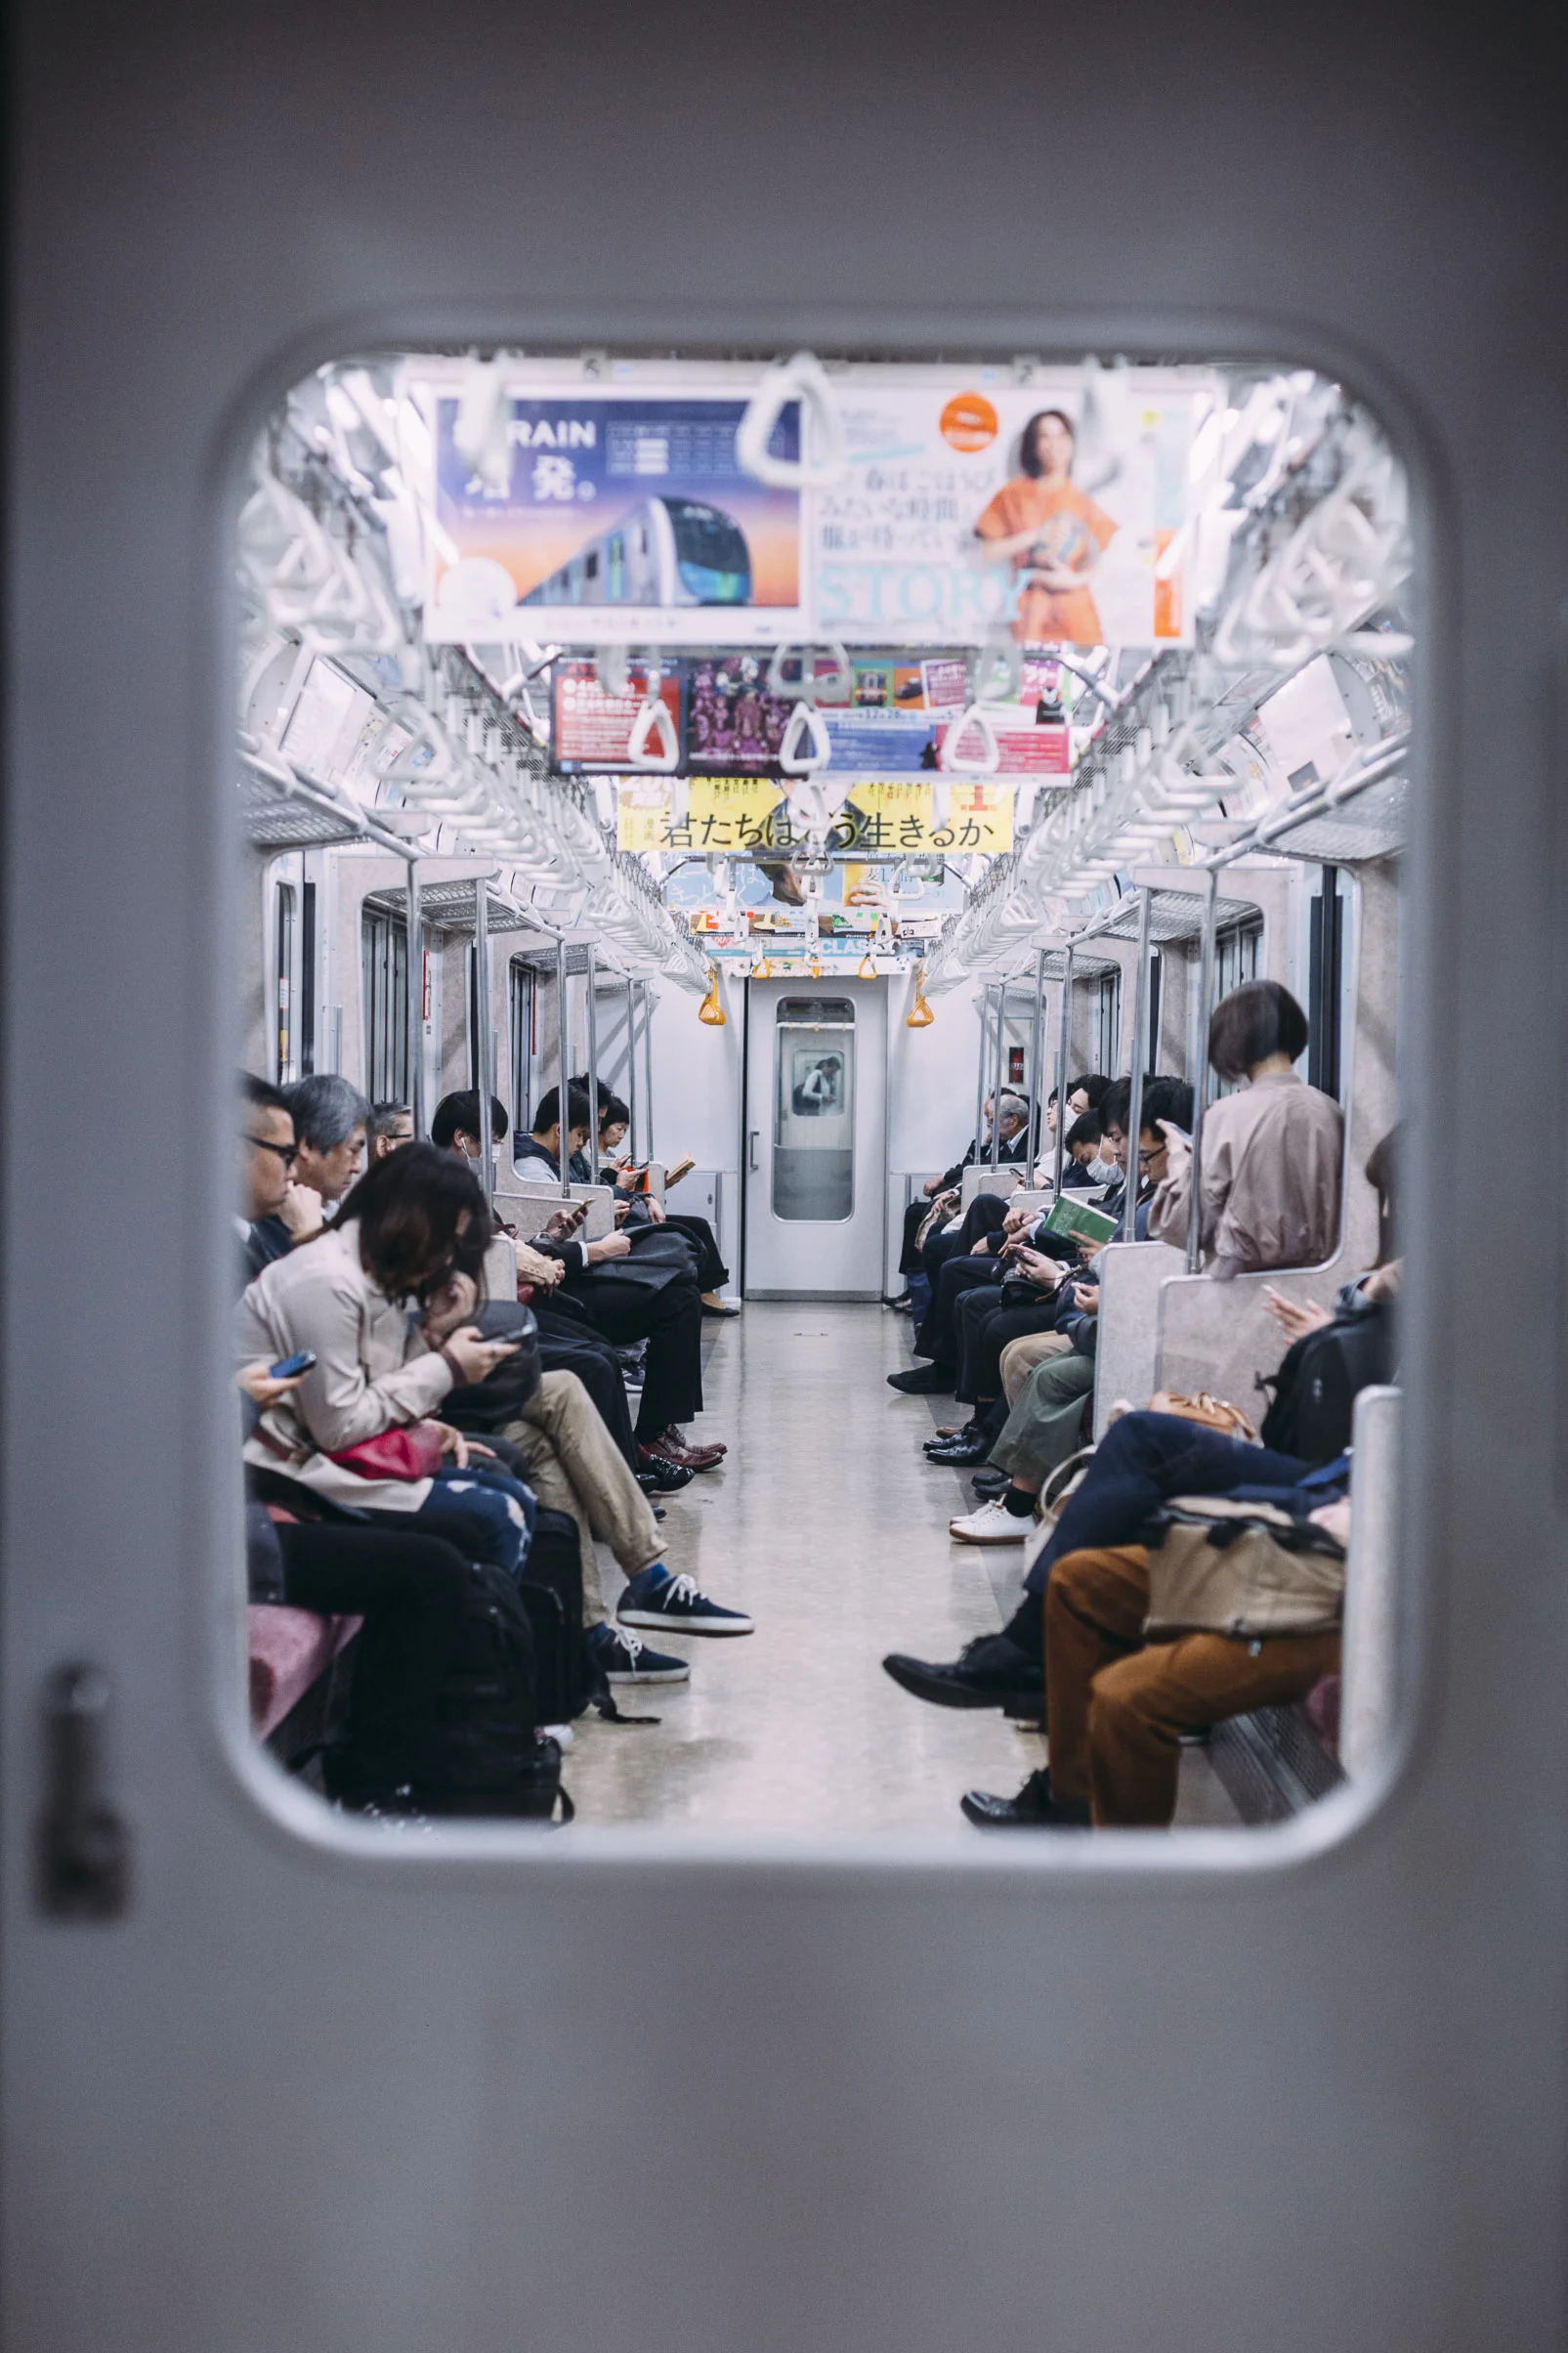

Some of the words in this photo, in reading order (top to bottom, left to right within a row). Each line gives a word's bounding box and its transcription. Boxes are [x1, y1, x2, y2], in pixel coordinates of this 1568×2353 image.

[507, 419, 596, 448] RAIN
[819, 565, 1035, 621] STORY
[659, 811, 995, 848] 君たちはう生きるか
